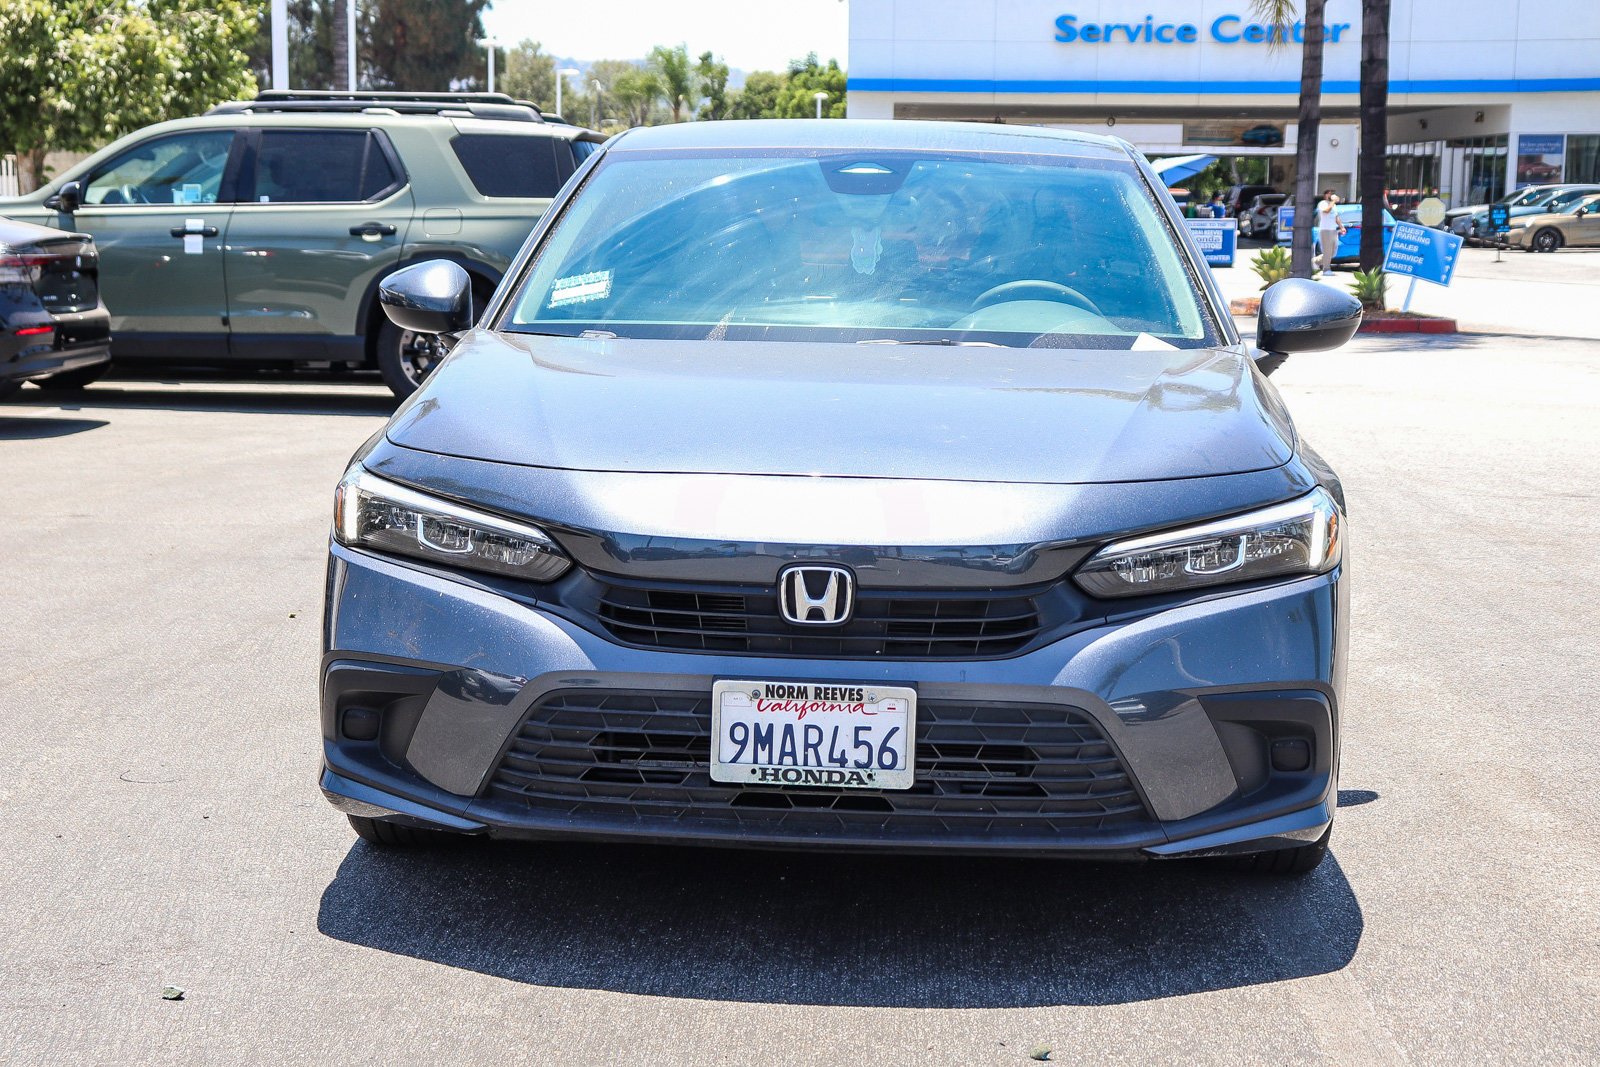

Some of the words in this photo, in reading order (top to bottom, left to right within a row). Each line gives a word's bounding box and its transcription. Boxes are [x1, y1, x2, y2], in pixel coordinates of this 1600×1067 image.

[1054, 14, 1197, 43] Service
[1396, 231, 1431, 245] PARKING
[1399, 225, 1425, 235] GUEST
[1393, 241, 1419, 252] SALES
[1391, 252, 1424, 264] SERVICE
[1388, 261, 1413, 272] PARTS
[765, 684, 809, 700] NORM
[814, 686, 864, 702] REEVES
[757, 699, 878, 720] California
[728, 721, 900, 770] 9MAR456
[758, 767, 868, 786] HONDA
